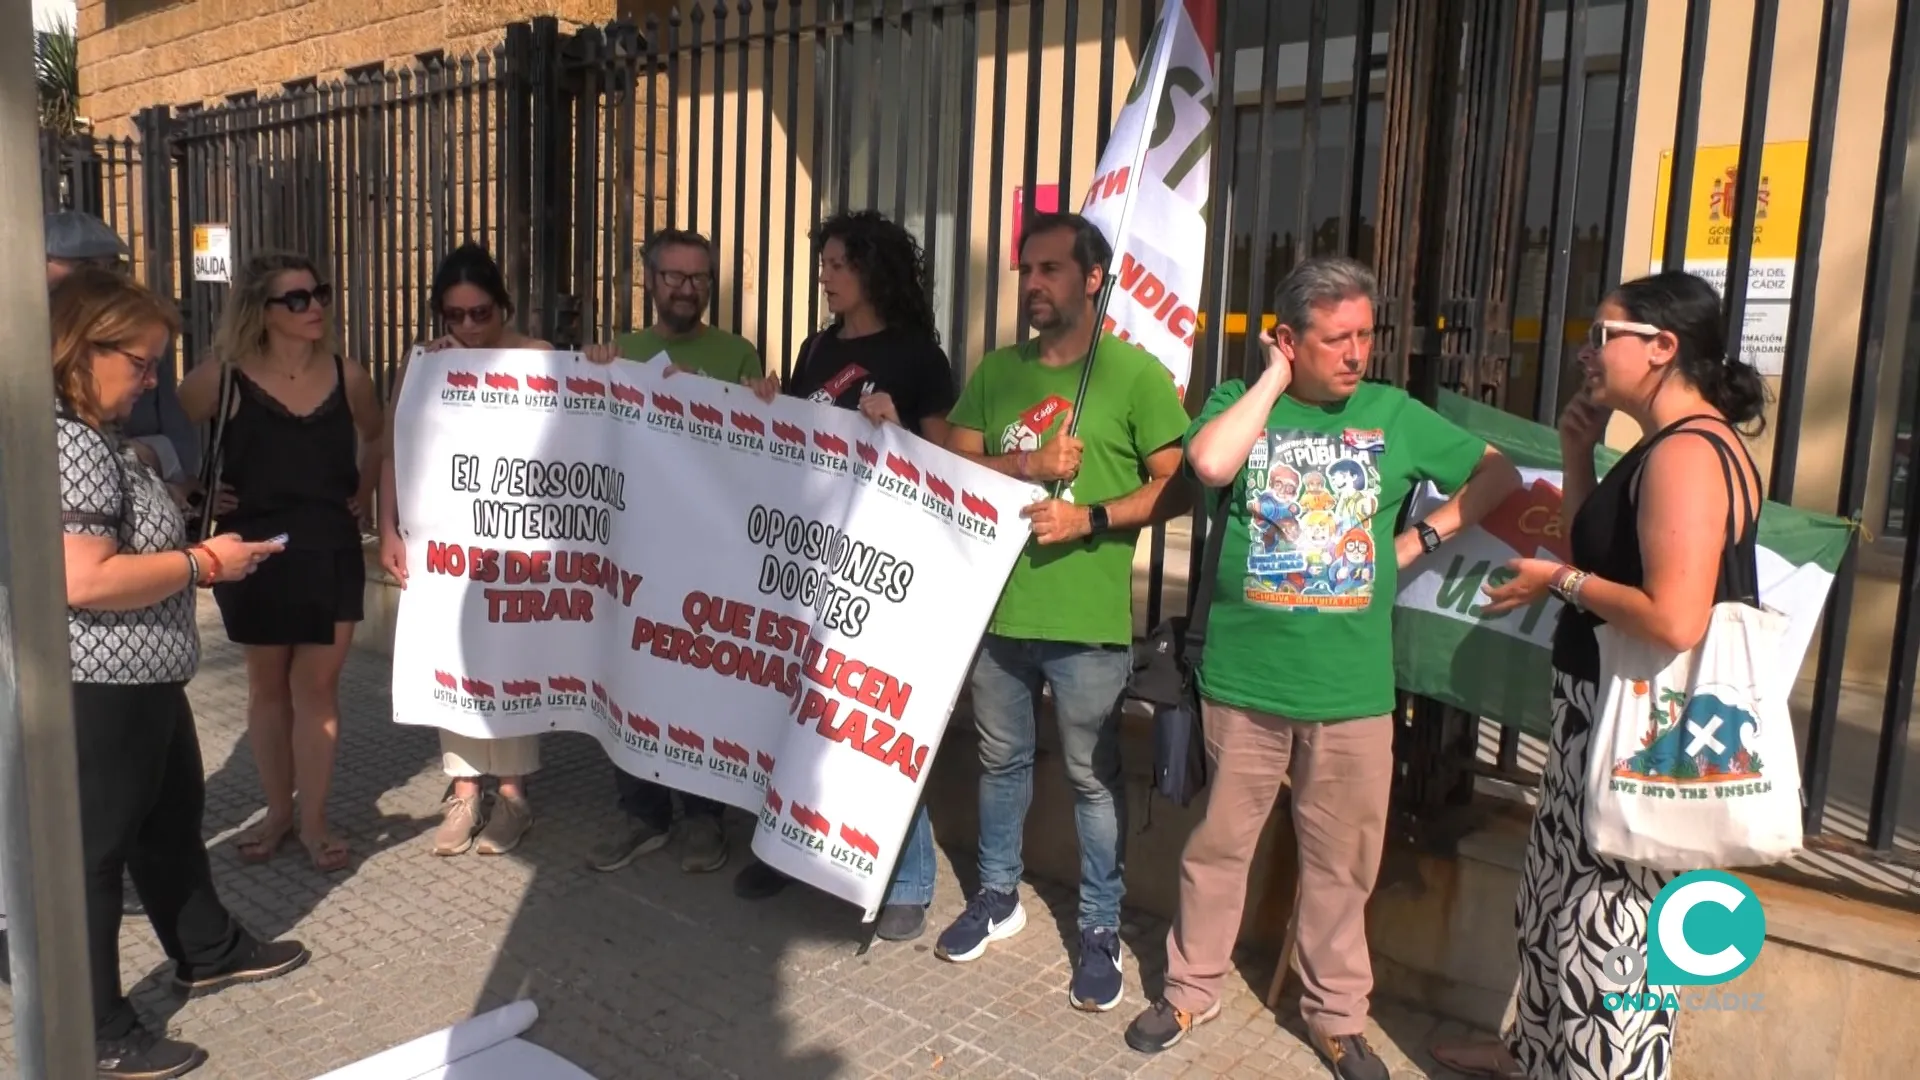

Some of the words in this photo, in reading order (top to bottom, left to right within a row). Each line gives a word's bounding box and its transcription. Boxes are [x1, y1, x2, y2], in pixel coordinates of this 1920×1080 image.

[195, 256, 227, 275] SALIDA
[1767, 268, 1786, 278] DEL
[441, 389, 476, 402] USTEA
[481, 392, 519, 405] USTEA
[525, 394, 558, 408] USTEA
[564, 396, 606, 411] USTEA
[609, 400, 641, 420] USTEA
[646, 411, 684, 431] USTEA
[688, 421, 722, 441] USTEA
[727, 432, 764, 451] USTEA
[769, 442, 805, 462] USTEA
[810, 452, 848, 472] USTEA
[878, 473, 918, 501] USTEA
[922, 491, 954, 521] USTEA
[958, 513, 997, 541] USTEA
[452, 454, 480, 492] EL
[473, 499, 611, 545] INTERINO
[427, 540, 466, 577] NO
[468, 546, 500, 583] ES
[504, 550, 551, 584] DE
[620, 569, 644, 607] Y
[484, 588, 594, 623] TIRAR
[682, 590, 755, 640] QUE
[631, 616, 801, 698] PERSONAS
[434, 689, 458, 705] USTEA
[461, 696, 496, 712] USTEA
[501, 696, 542, 711] USTEA
[547, 694, 587, 707] USTEA
[624, 731, 658, 753] USTEA
[664, 744, 703, 765] USTEA
[709, 757, 747, 778] USTEA
[1641, 785, 1676, 799] INTO
[1680, 787, 1708, 800] THE
[1713, 780, 1773, 798] UNSEEN
[781, 820, 824, 853] USTEA
[830, 844, 874, 875] USTEA
